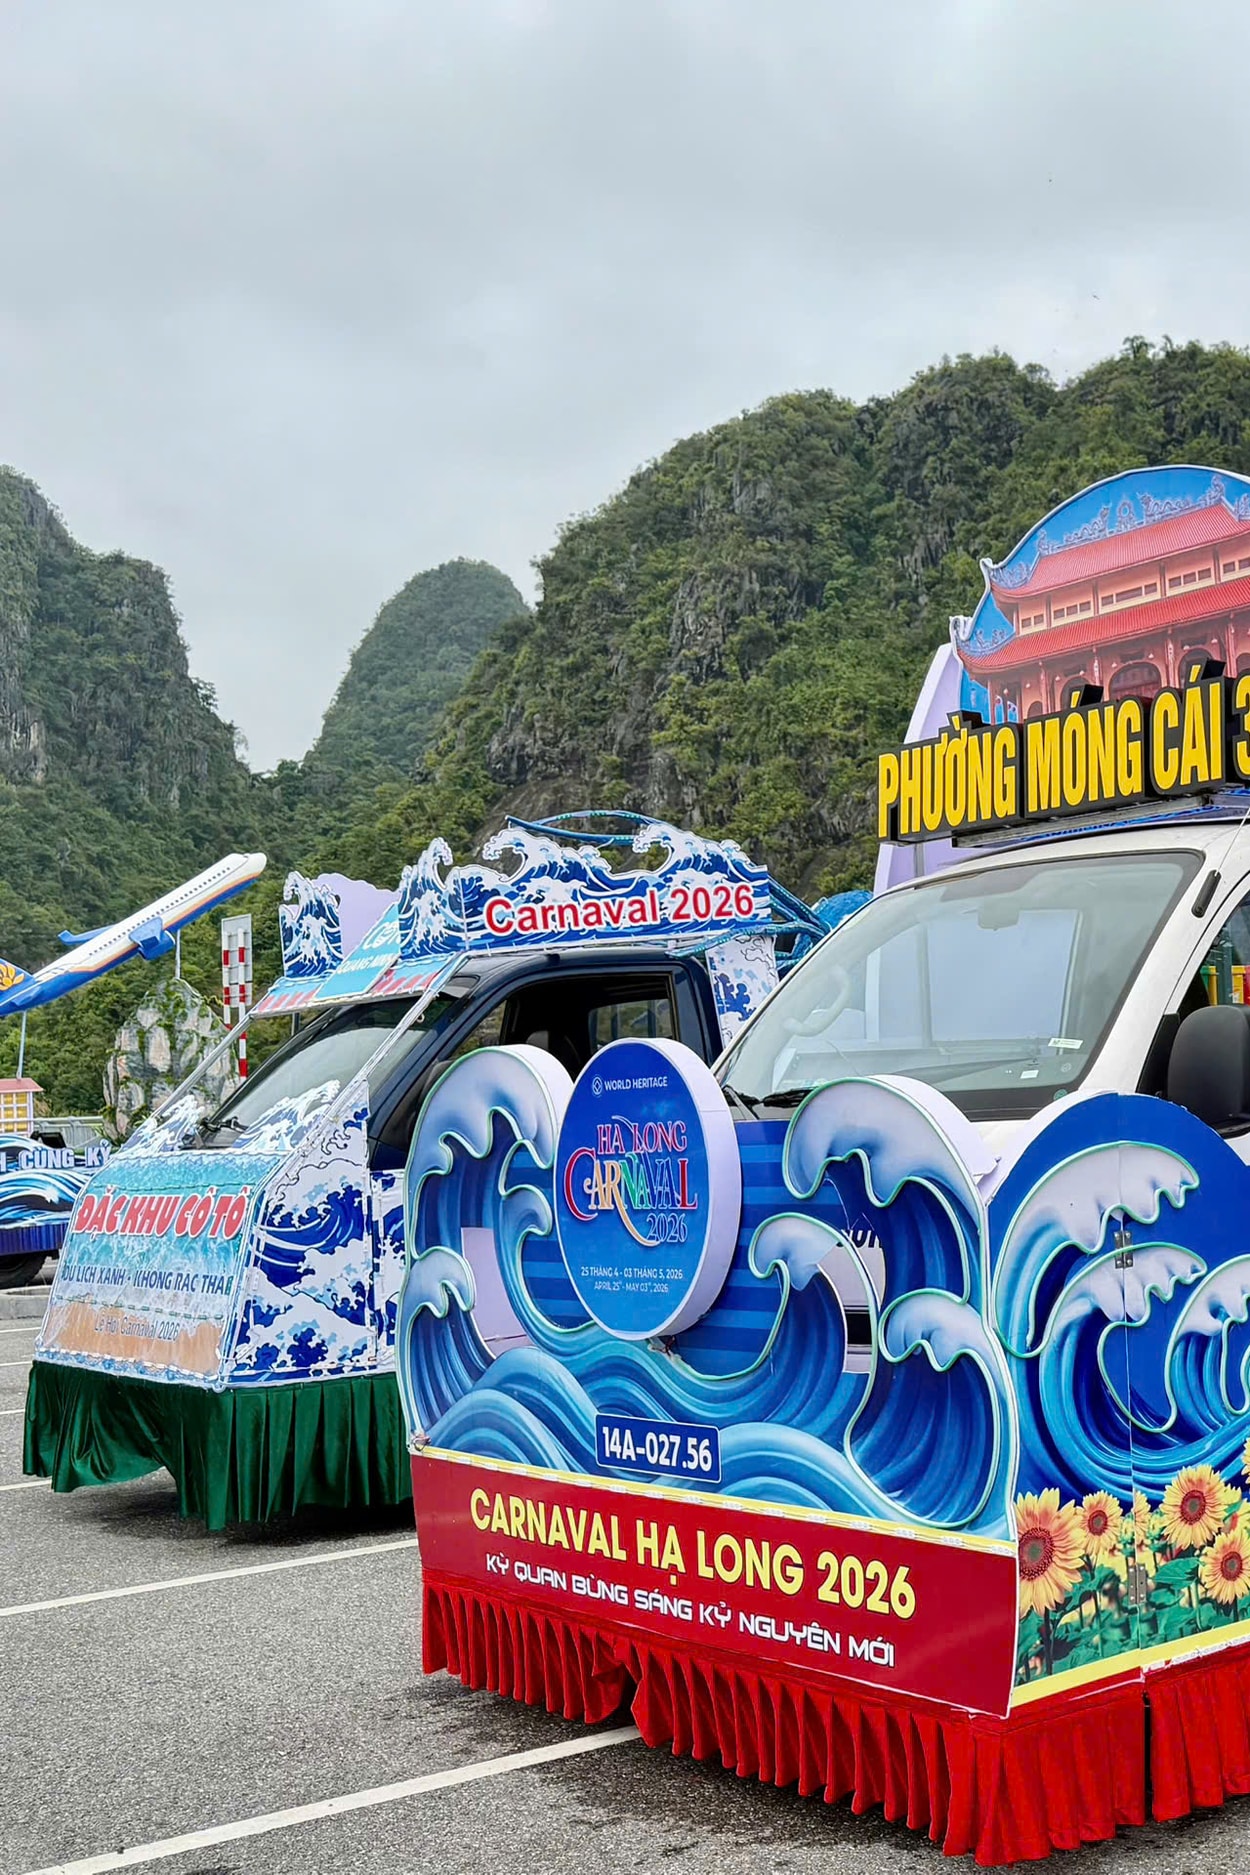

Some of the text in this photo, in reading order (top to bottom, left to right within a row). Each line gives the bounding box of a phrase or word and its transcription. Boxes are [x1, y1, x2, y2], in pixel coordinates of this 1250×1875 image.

[878, 714, 1017, 839] PHƯỜNG
[1027, 691, 1142, 810] MÓNG
[1152, 665, 1225, 792] CÁI
[486, 884, 754, 933] Carnaval 2026
[604, 1076, 668, 1091] WORLD HERITAGE
[632, 1121, 687, 1154] LONG
[73, 1185, 249, 1241] ĐẶC KHU CÔ TÔ
[564, 1147, 697, 1245] CARNAVAL
[647, 1212, 688, 1243] 2026
[98, 1267, 126, 1286] XANH
[581, 1266, 589, 1276] 25
[624, 1267, 632, 1277] 03
[666, 1269, 683, 1279] 2026
[626, 1282, 640, 1292] MAY
[653, 1283, 668, 1293] 2026
[157, 1320, 180, 1341] 2026
[602, 1425, 712, 1471] 14A-027.56
[470, 1487, 916, 1619] CARNAVAL HẠ LONG 2026
[486, 1553, 509, 1575] KỲ
[514, 1561, 567, 1591] QUAN
[634, 1588, 693, 1620] SÁNG
[699, 1601, 732, 1628] KỶ
[739, 1612, 841, 1654] NGUYÊN
[848, 1636, 895, 1667] MỚI
